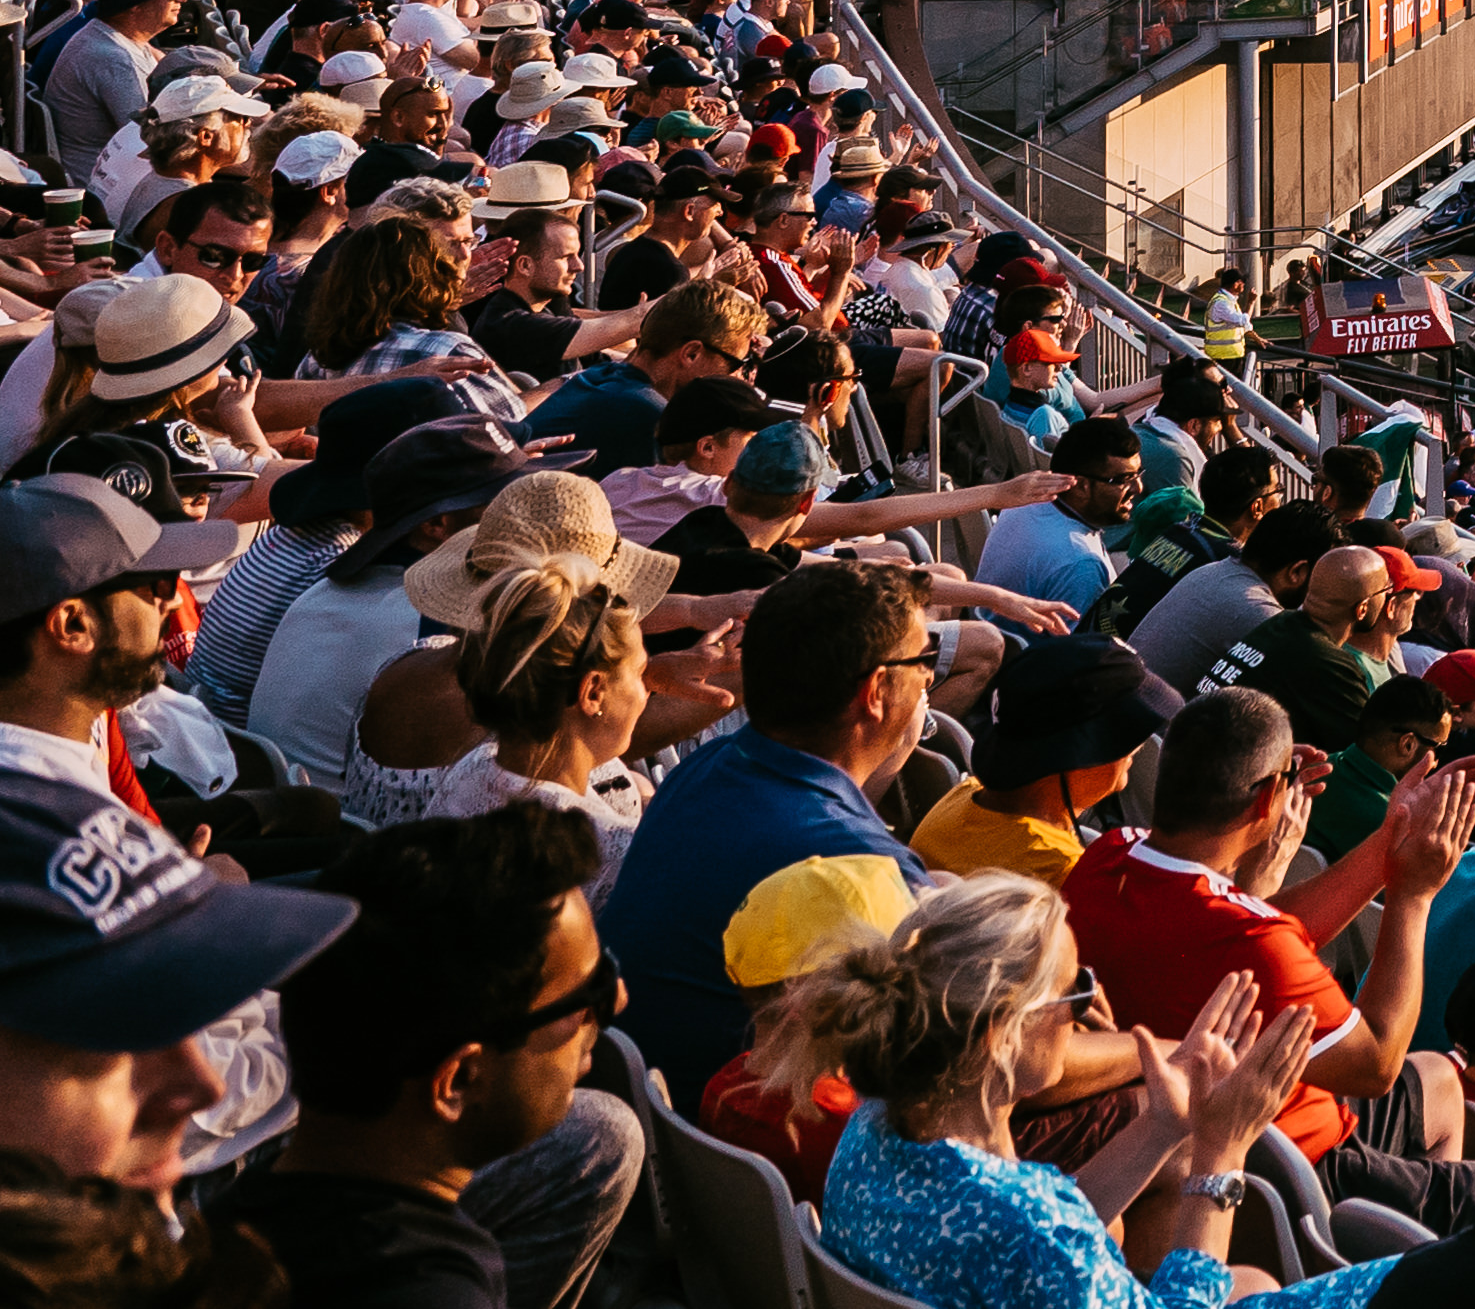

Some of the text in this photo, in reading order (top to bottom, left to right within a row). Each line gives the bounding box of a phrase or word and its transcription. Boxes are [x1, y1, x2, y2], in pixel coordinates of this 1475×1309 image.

[1330, 314, 1432, 338] Emirates
[1346, 333, 1417, 354] FLY BETTER
[1227, 641, 1266, 669] PROUD
[1220, 664, 1243, 685] BE
